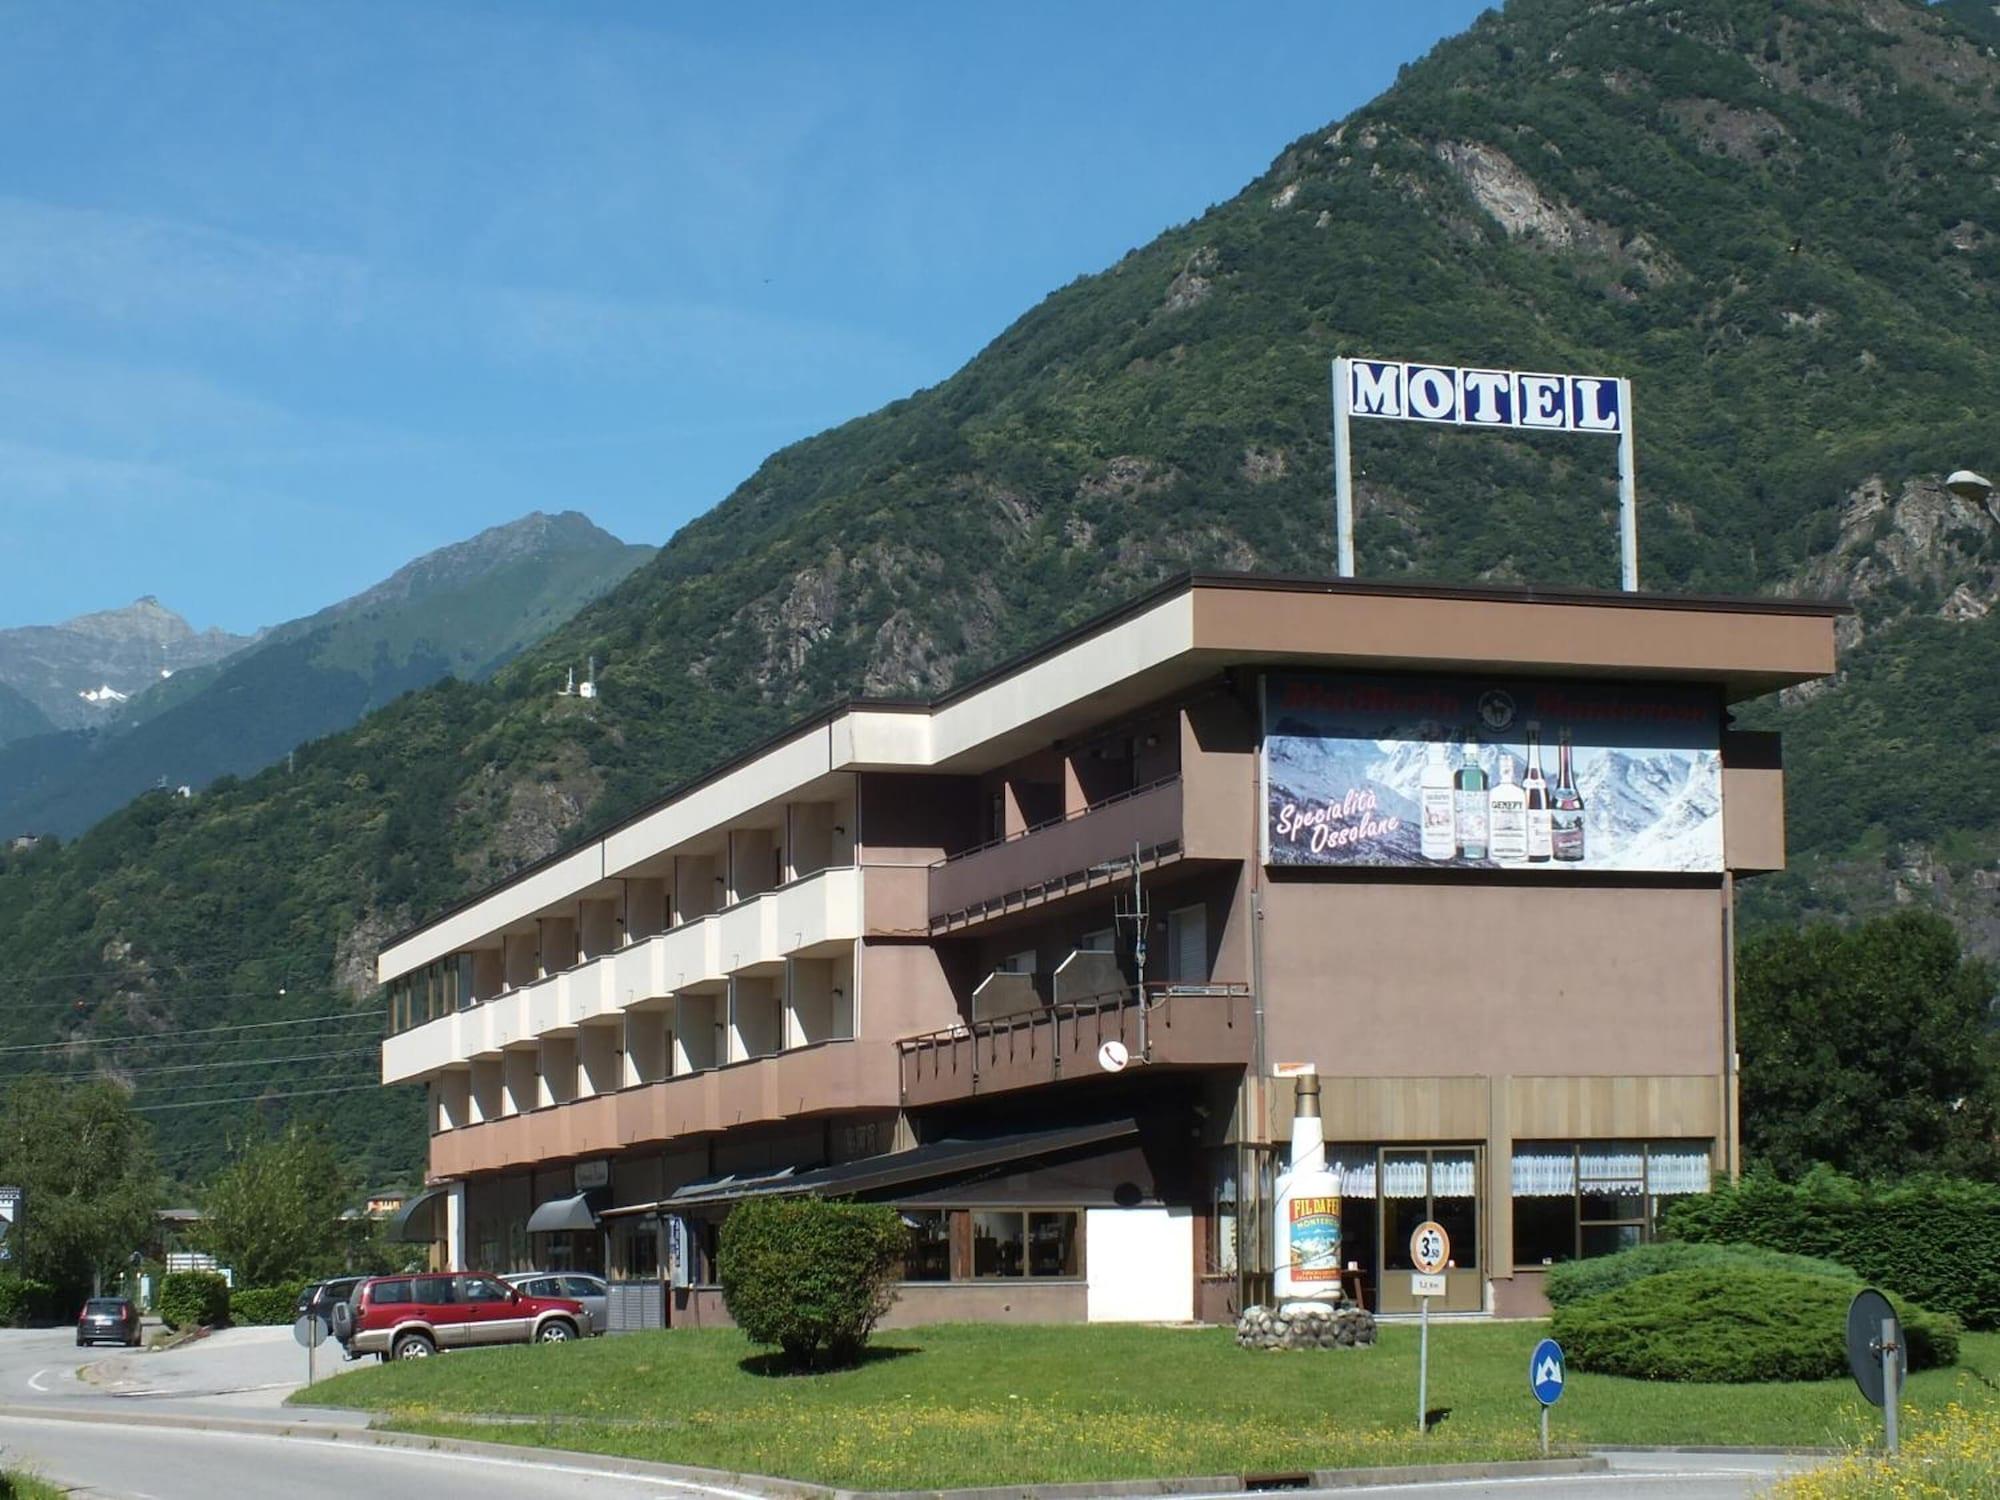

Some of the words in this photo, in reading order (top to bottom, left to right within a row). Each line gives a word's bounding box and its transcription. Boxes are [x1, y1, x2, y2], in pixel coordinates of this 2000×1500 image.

[1352, 362, 1617, 430] MOTEL
[1276, 788, 1377, 842] Specialità
[1310, 811, 1399, 853] Ossolane
